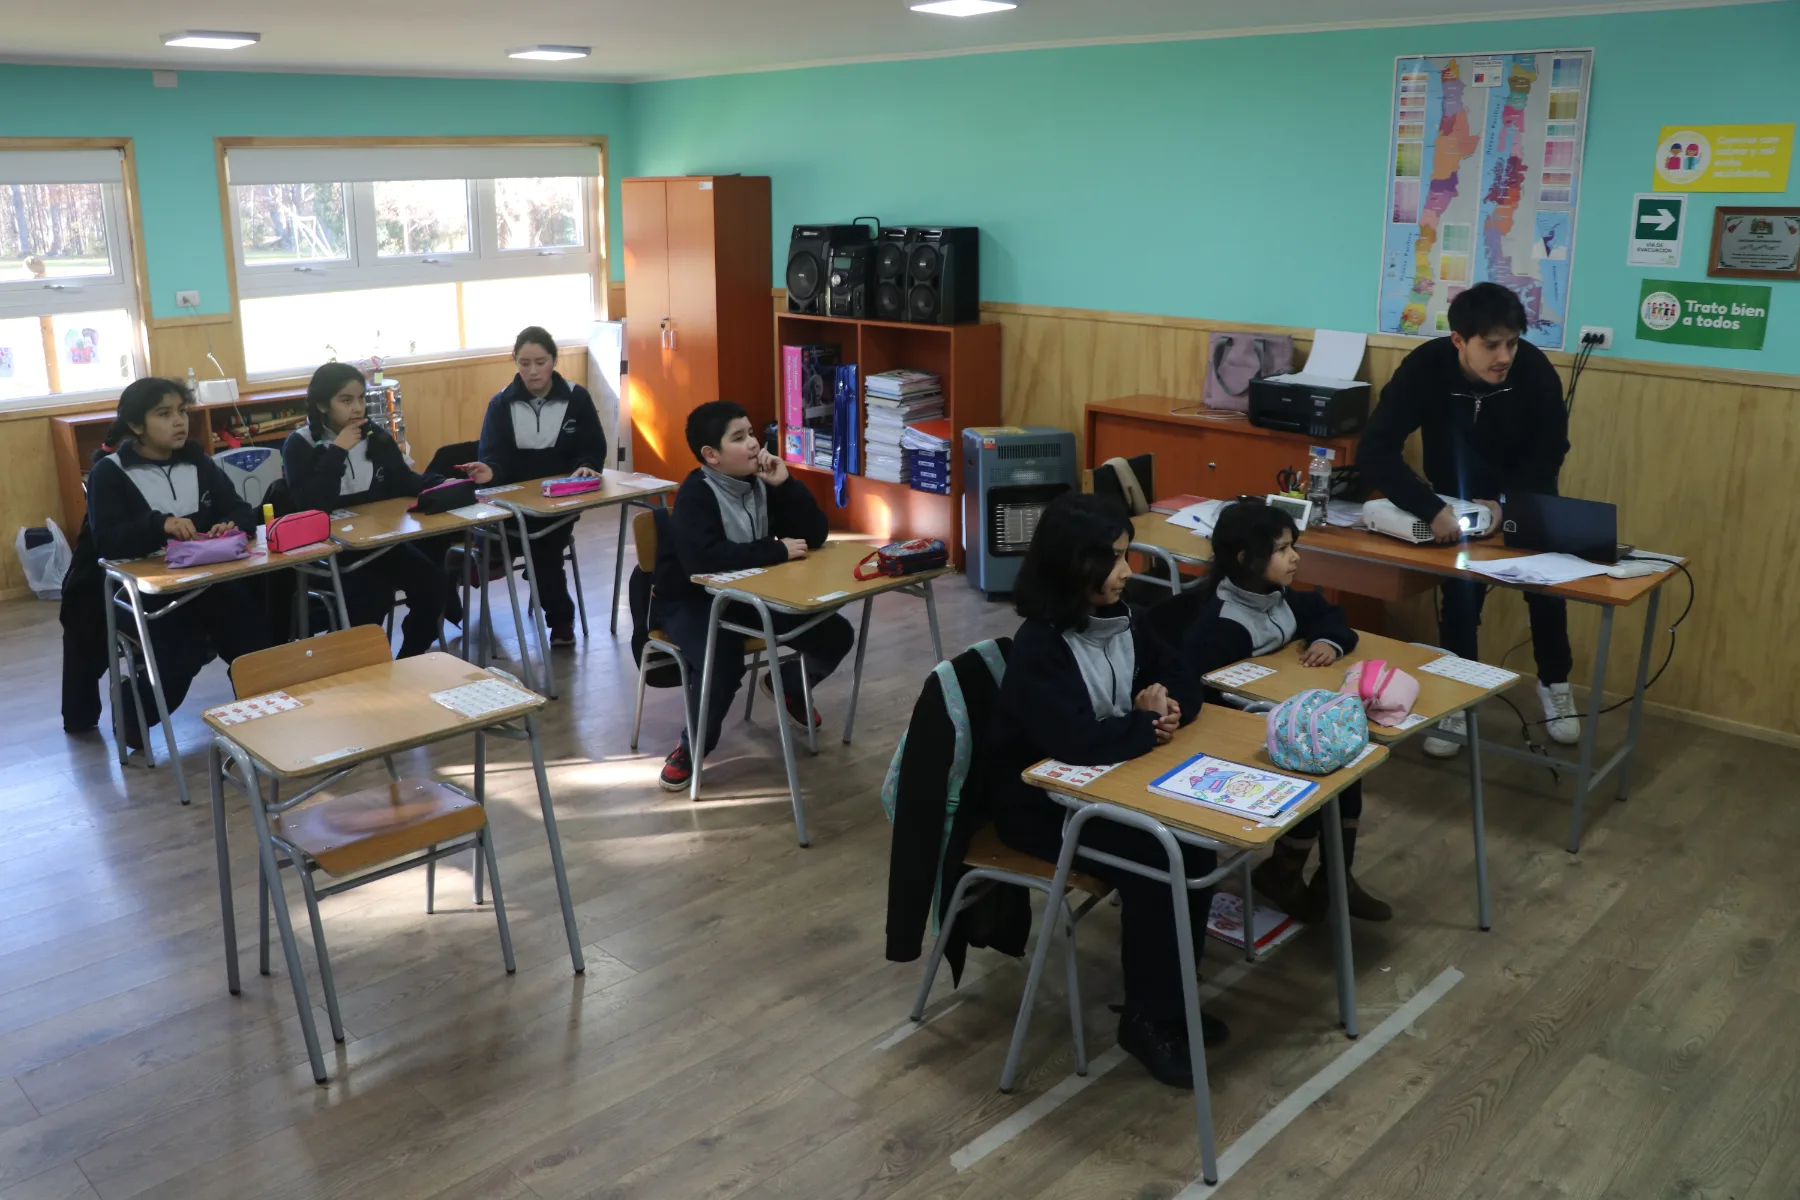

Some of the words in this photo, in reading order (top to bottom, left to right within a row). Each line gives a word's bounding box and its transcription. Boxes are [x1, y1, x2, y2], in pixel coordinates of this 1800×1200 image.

[1684, 299, 1728, 315] Trato
[1731, 301, 1765, 318] bien
[1682, 317, 1692, 326] a
[1696, 316, 1741, 330] todos
